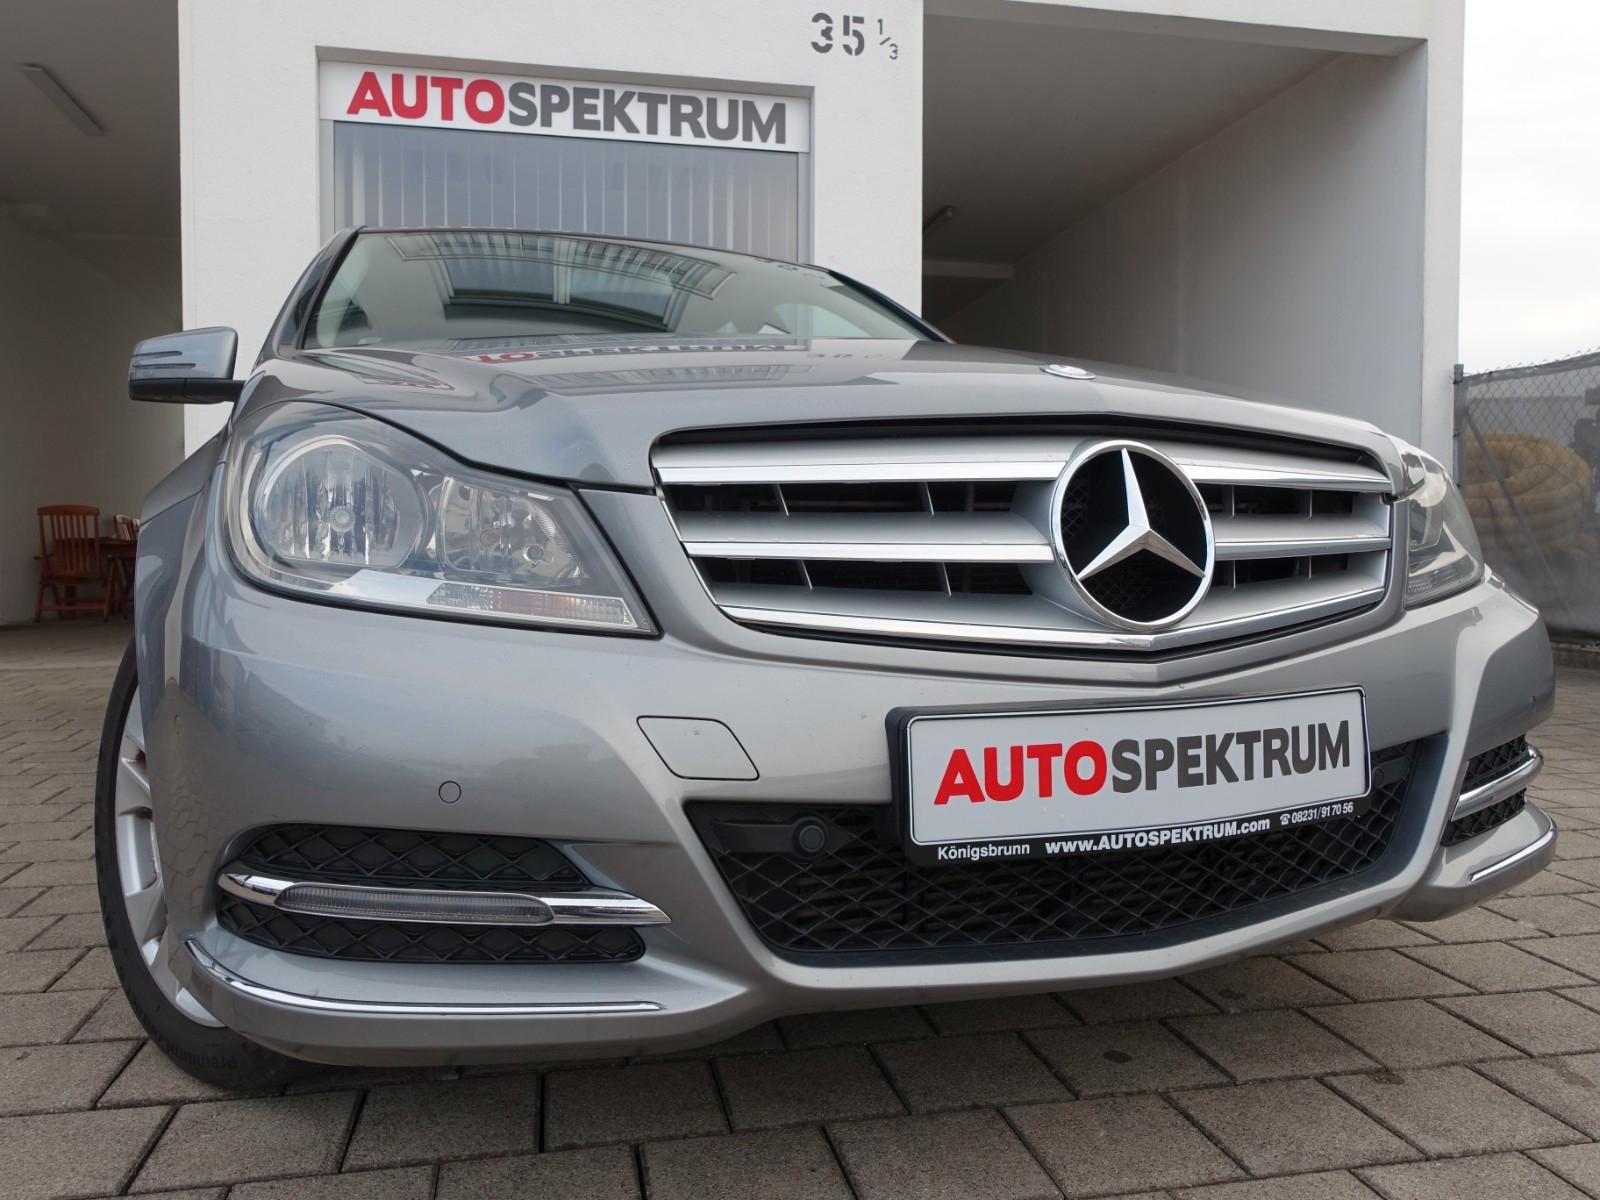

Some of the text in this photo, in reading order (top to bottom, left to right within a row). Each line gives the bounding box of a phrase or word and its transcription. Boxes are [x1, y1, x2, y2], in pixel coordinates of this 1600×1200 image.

[811, 12, 864, 56] 35
[346, 71, 786, 145] AUTOSPEKTRUM
[933, 719, 1350, 805] AUTOSPEKTRUM
[937, 843, 1030, 861] Königsbrunn
[1045, 818, 1270, 854] www.AUTOSPEKTRUM.com
